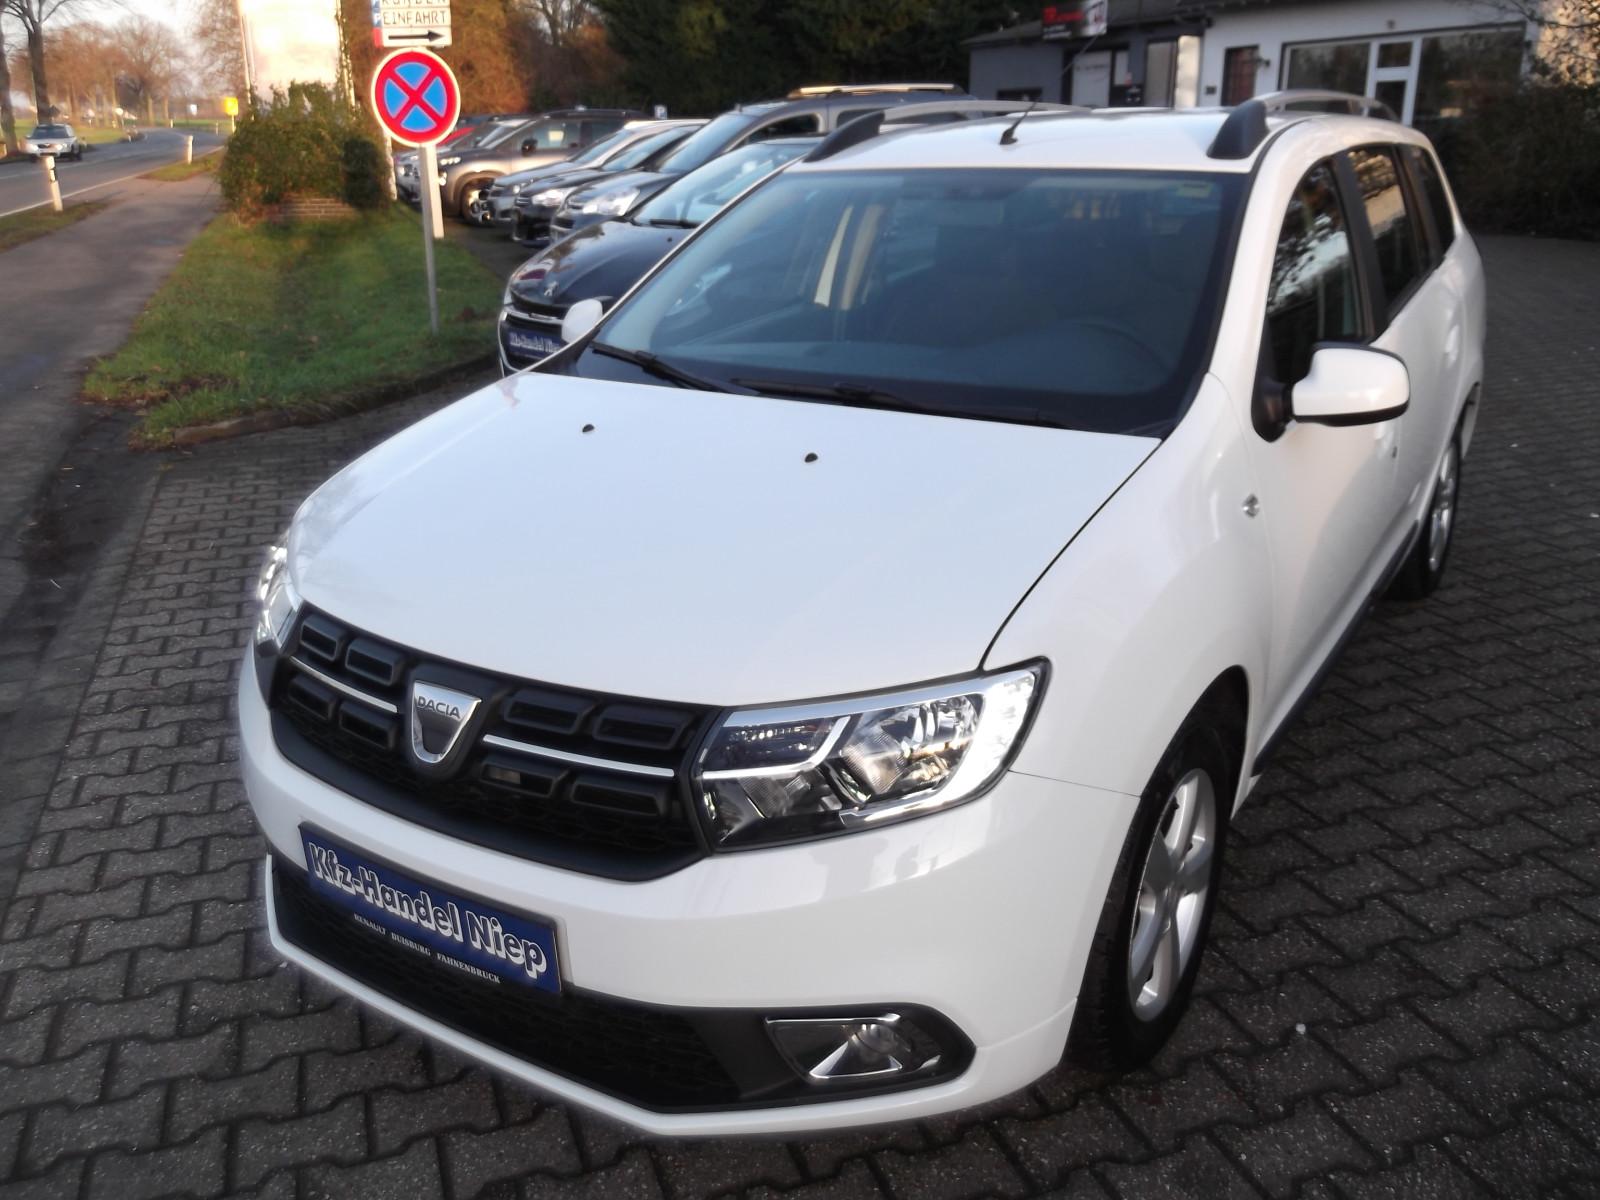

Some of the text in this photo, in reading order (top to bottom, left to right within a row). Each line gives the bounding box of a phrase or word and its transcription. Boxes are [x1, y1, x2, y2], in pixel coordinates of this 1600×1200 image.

[382, 10, 445, 24] EINFAHRT
[417, 696, 461, 719] DACIA
[309, 842, 547, 979] Kfz-Handel Niep
[354, 913, 386, 935] RENAULT
[391, 932, 431, 956] DUISBURG
